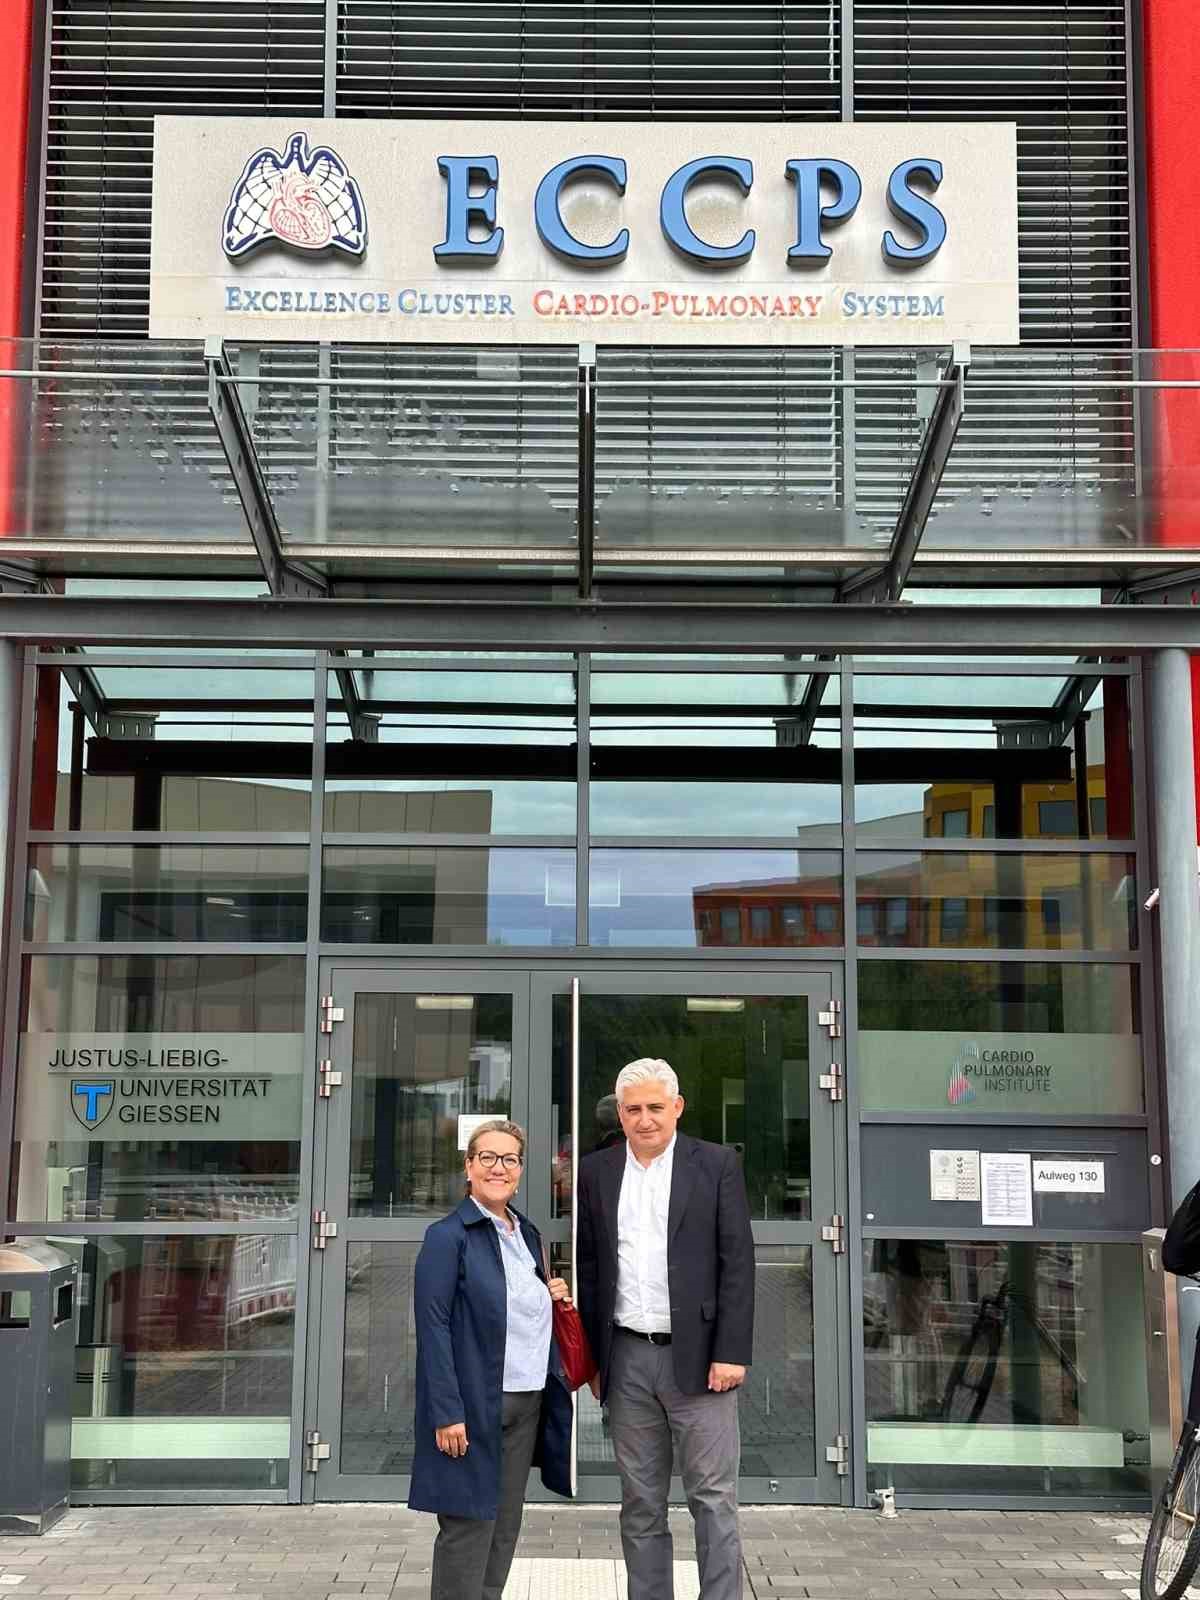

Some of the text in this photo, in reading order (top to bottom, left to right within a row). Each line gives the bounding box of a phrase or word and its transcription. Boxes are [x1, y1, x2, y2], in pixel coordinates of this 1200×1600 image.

[433, 154, 948, 266] ECCPS
[225, 286, 945, 318] EXCELLENCE CLUSTER CARDIO-PULMONARY SYSTEM
[48, 1048, 229, 1068] JUSTUS-LIEBIG-
[982, 1050, 1034, 1063] CARDIO
[964, 1064, 1052, 1077] PULMONARY
[120, 1077, 272, 1097] UNIVERSITÄT
[984, 1079, 1051, 1092] INSTITUTE
[118, 1104, 220, 1123] GIESSEN
[1038, 1170, 1098, 1183] Aulweg 130
